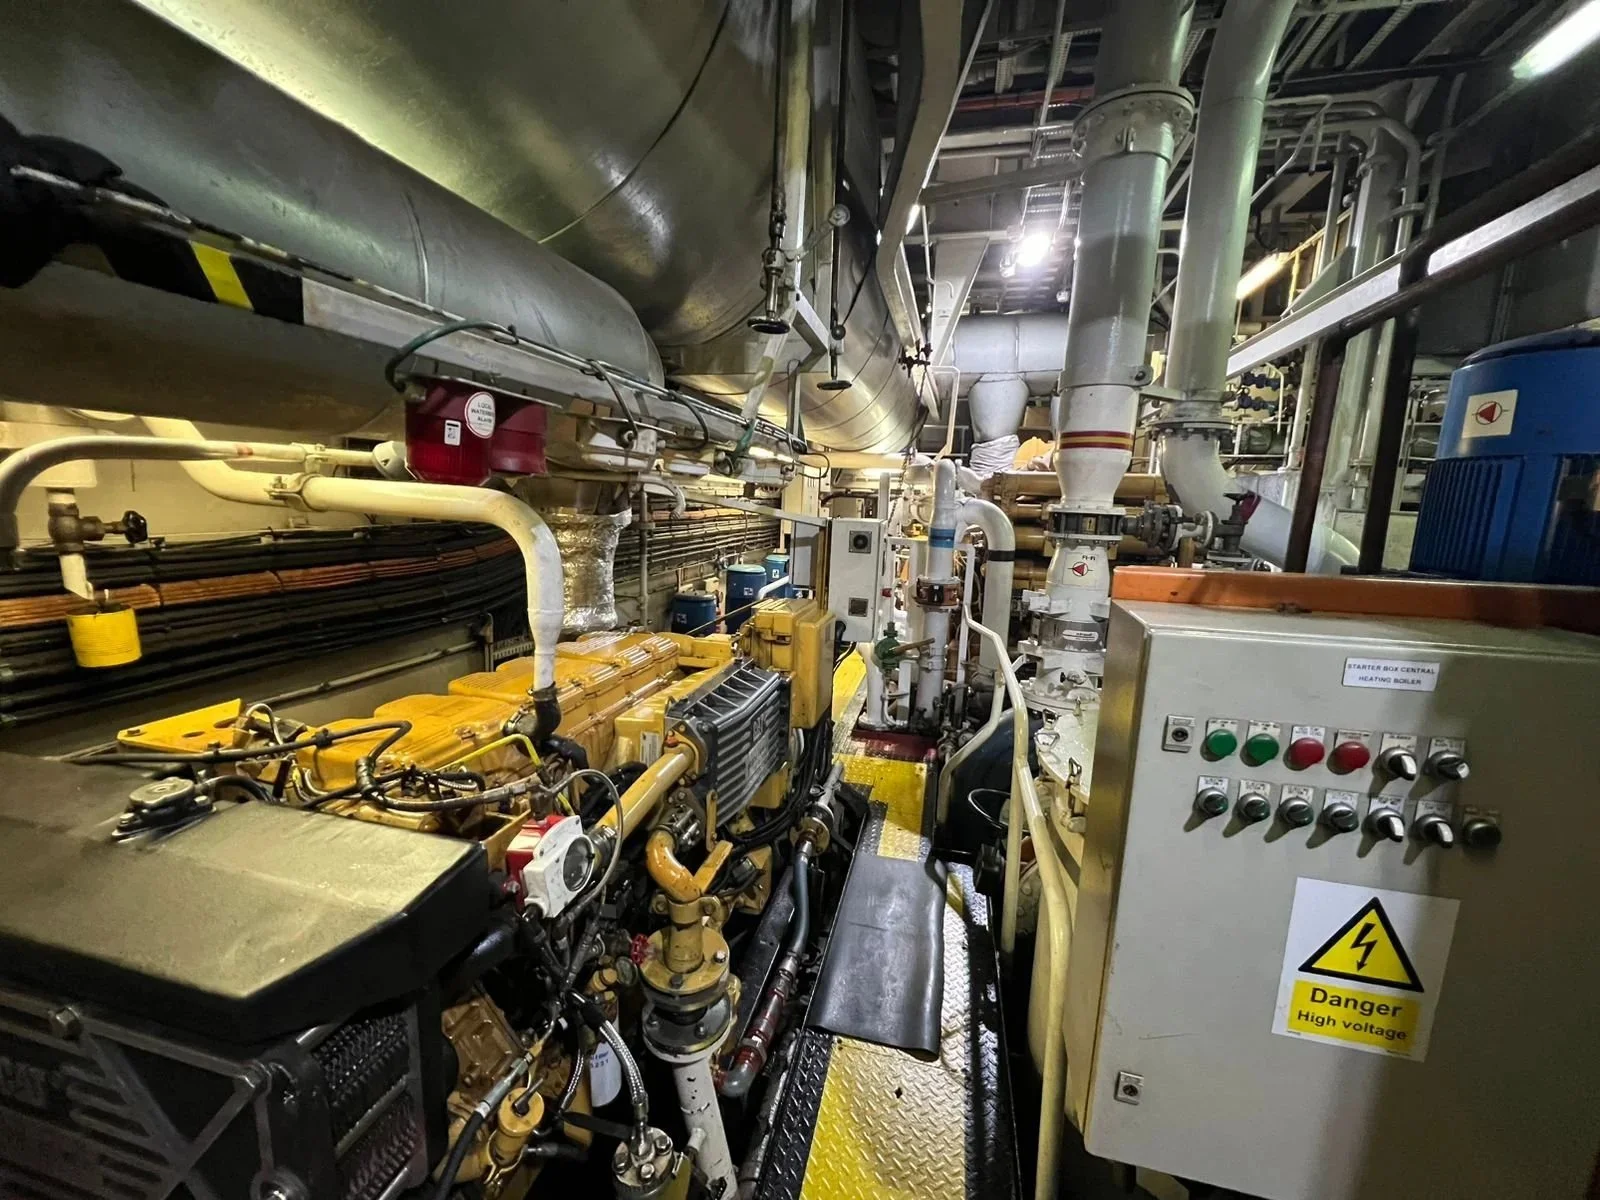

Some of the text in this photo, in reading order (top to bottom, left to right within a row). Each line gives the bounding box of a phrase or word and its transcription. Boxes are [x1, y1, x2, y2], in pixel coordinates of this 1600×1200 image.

[1347, 663, 1381, 671] STARTER
[1310, 987, 1402, 1017] Danger
[1297, 1010, 1408, 1041] High voltage
